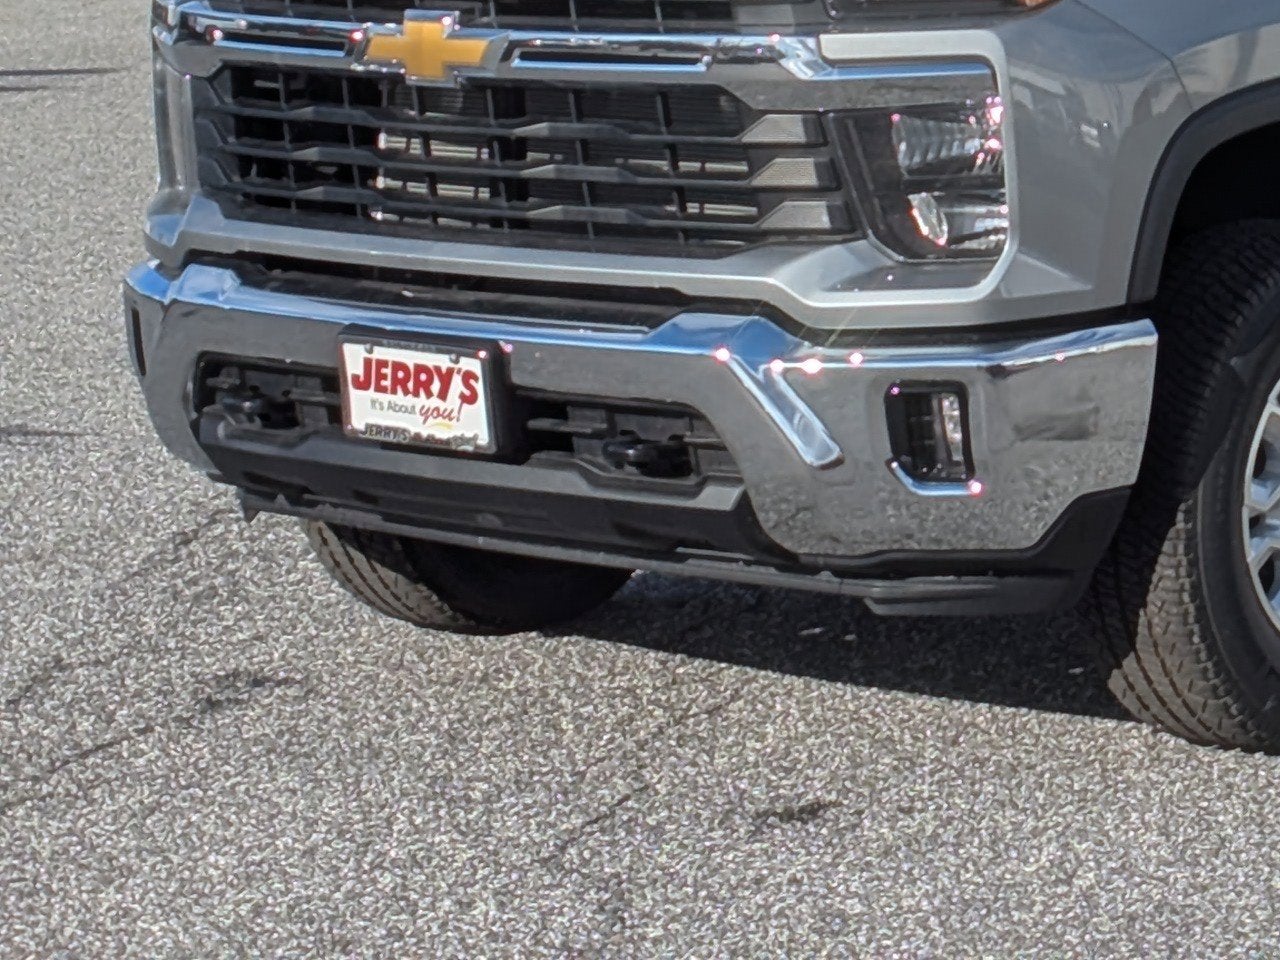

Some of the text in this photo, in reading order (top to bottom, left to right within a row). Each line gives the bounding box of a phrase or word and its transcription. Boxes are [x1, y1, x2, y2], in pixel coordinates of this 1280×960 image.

[351, 356, 480, 406] JERRY'S
[370, 397, 464, 426] It's About you!
